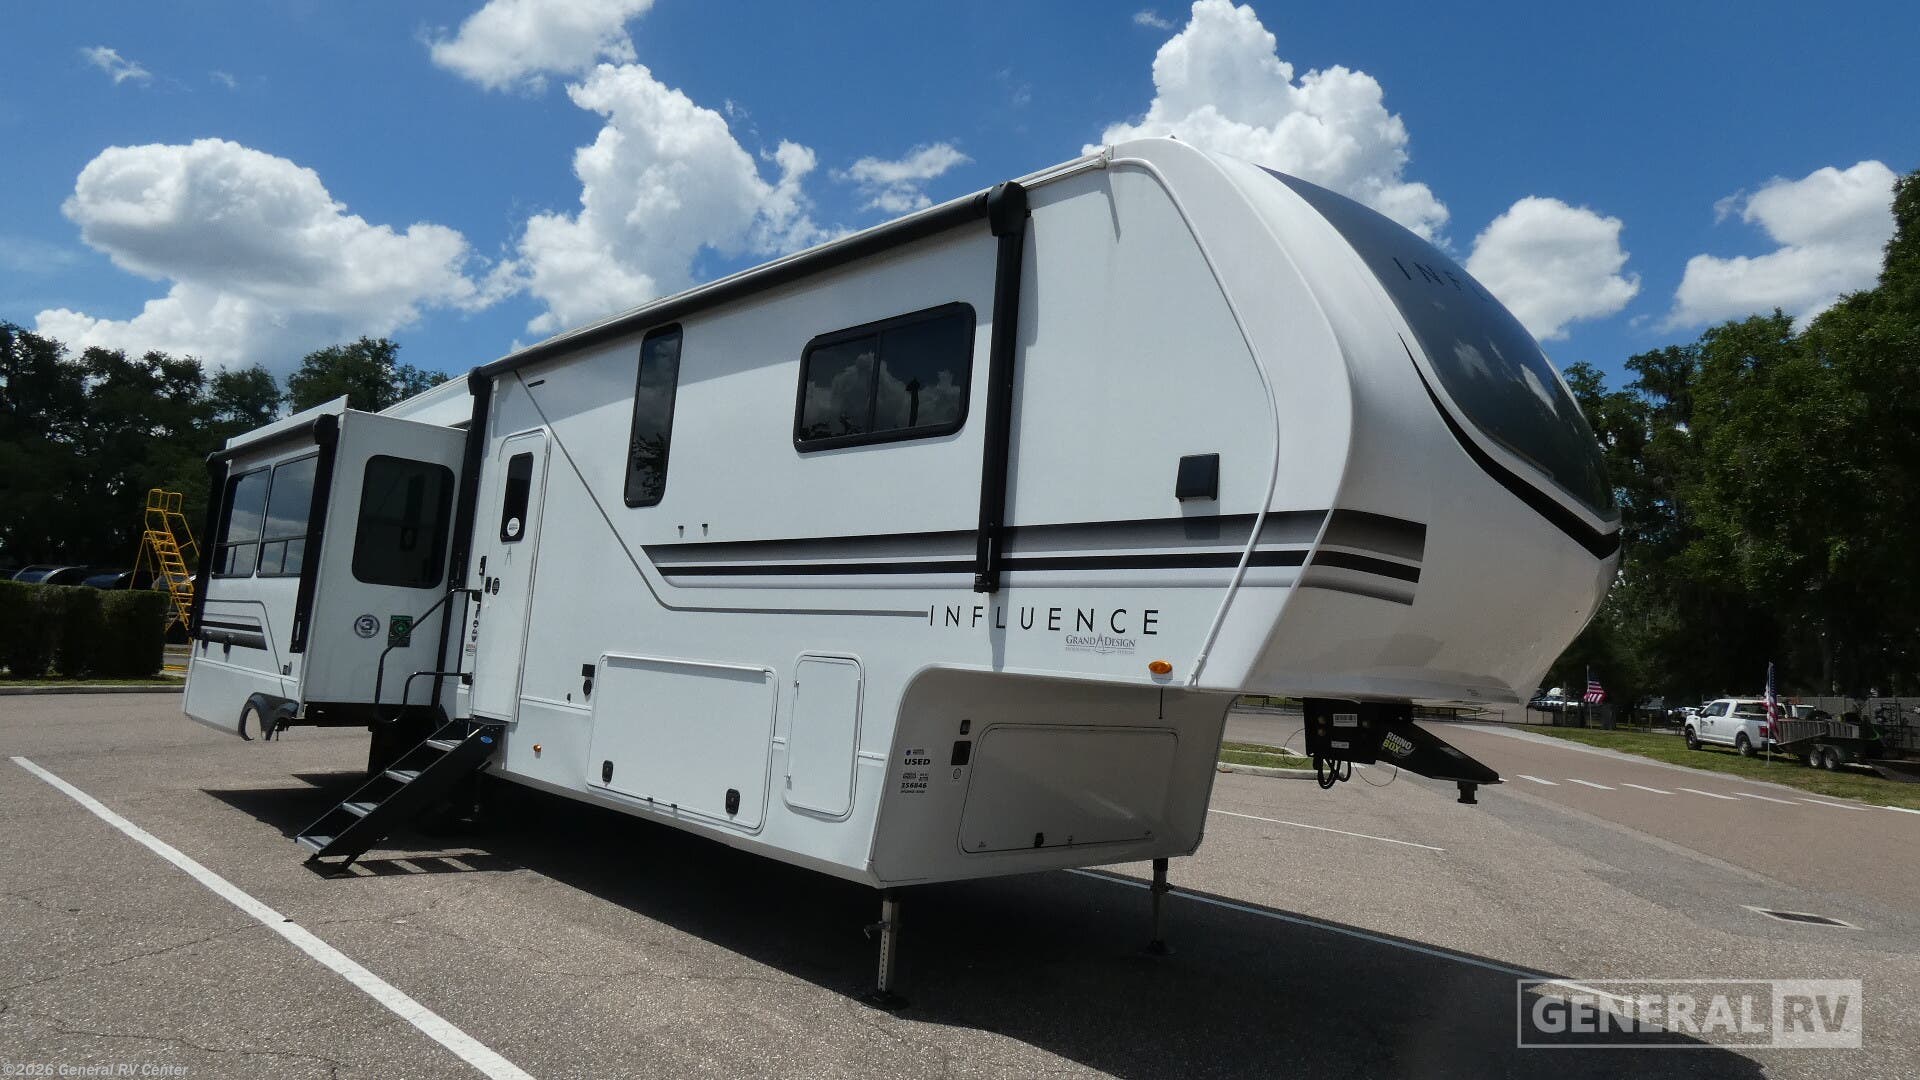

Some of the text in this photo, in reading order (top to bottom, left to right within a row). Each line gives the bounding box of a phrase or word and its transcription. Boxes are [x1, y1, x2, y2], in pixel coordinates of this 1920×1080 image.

[929, 604, 1159, 636] INFLUENCE
[1065, 634, 1136, 648] GRAND DESIGN
[1382, 738, 1401, 754] BOX
[1386, 731, 1413, 750] RHINO
[904, 758, 931, 766] USED
